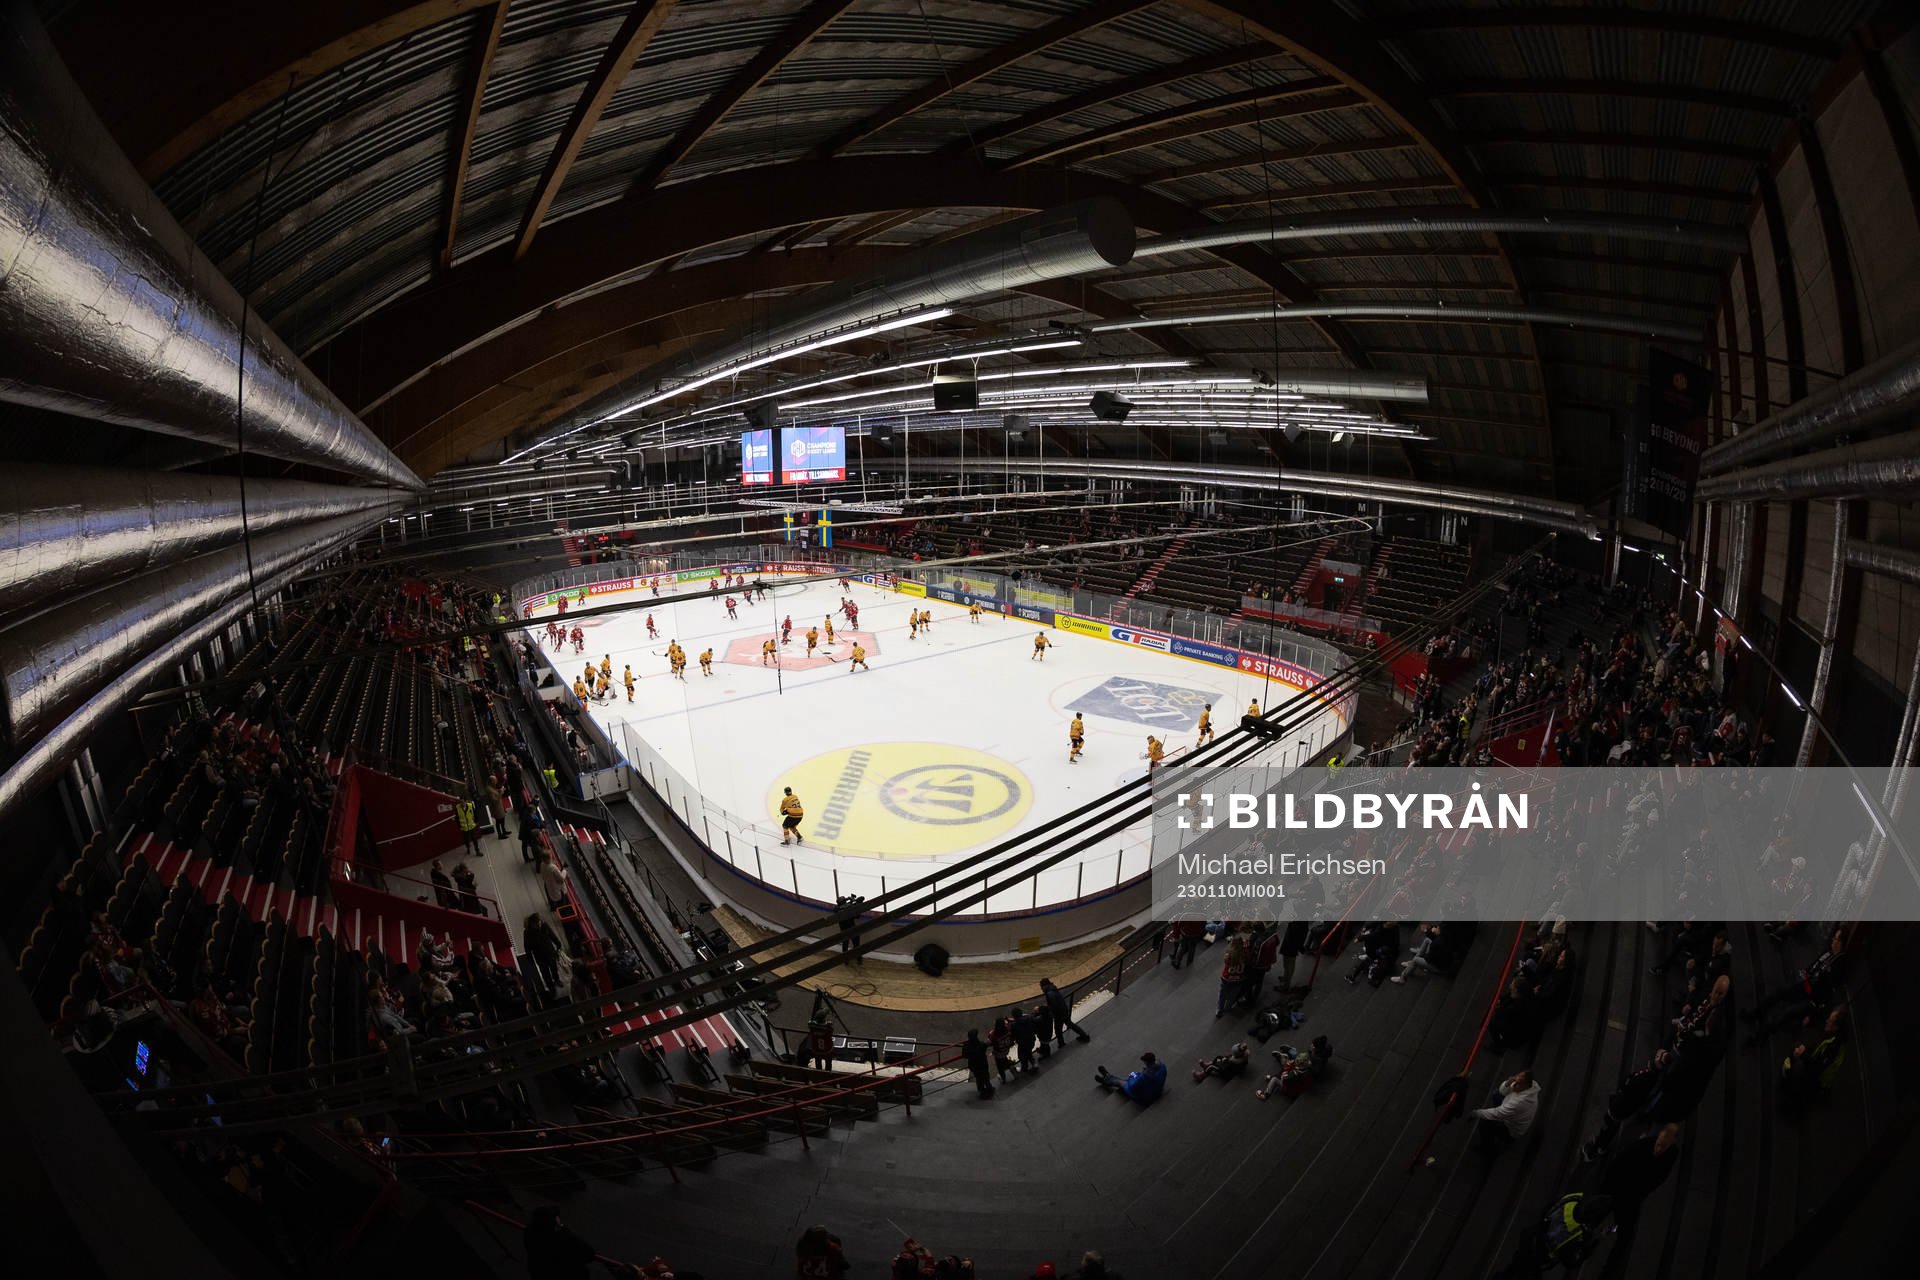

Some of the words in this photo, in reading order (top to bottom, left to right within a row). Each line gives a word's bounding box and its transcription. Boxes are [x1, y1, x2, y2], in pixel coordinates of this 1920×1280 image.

[1358, 502, 1367, 512] M
[1461, 515, 1468, 526] N
[598, 580, 632, 593] STRAUSS
[1111, 628, 1152, 645] GT
[1140, 636, 1167, 648] RADIAL
[1183, 646, 1202, 656] PRIVATE
[1202, 650, 1224, 662] BANKING
[1254, 660, 1304, 686] STRAUSS
[813, 749, 873, 840] WARRIOR
